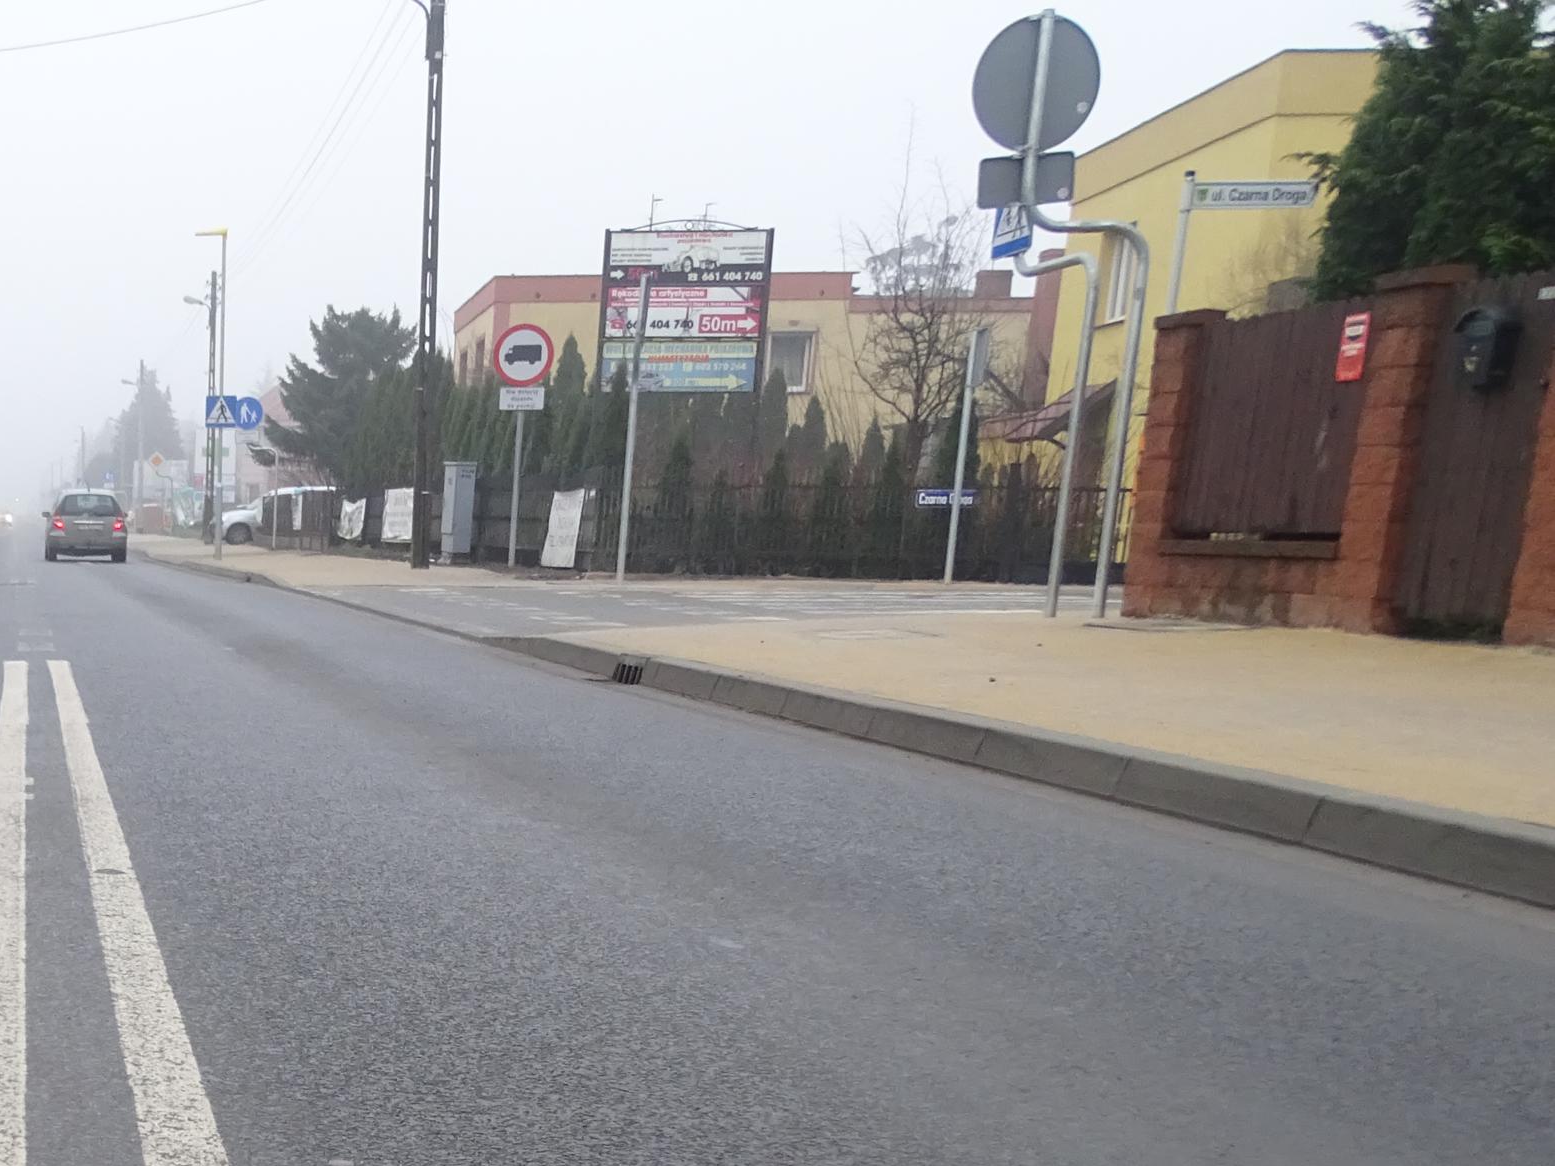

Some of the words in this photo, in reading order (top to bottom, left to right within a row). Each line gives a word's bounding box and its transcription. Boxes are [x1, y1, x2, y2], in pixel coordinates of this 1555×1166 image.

[1211, 190, 1225, 202] ul.
[1228, 189, 1268, 202] Czarna
[1272, 188, 1308, 205] Droga
[701, 272, 720, 282] 661
[723, 272, 742, 282] 404
[744, 271, 763, 281] 740
[649, 319, 670, 329] 404
[673, 319, 694, 329] 740
[700, 316, 736, 332] 50m
[918, 492, 948, 505] Czarna
[948, 493, 973, 506] Doga
